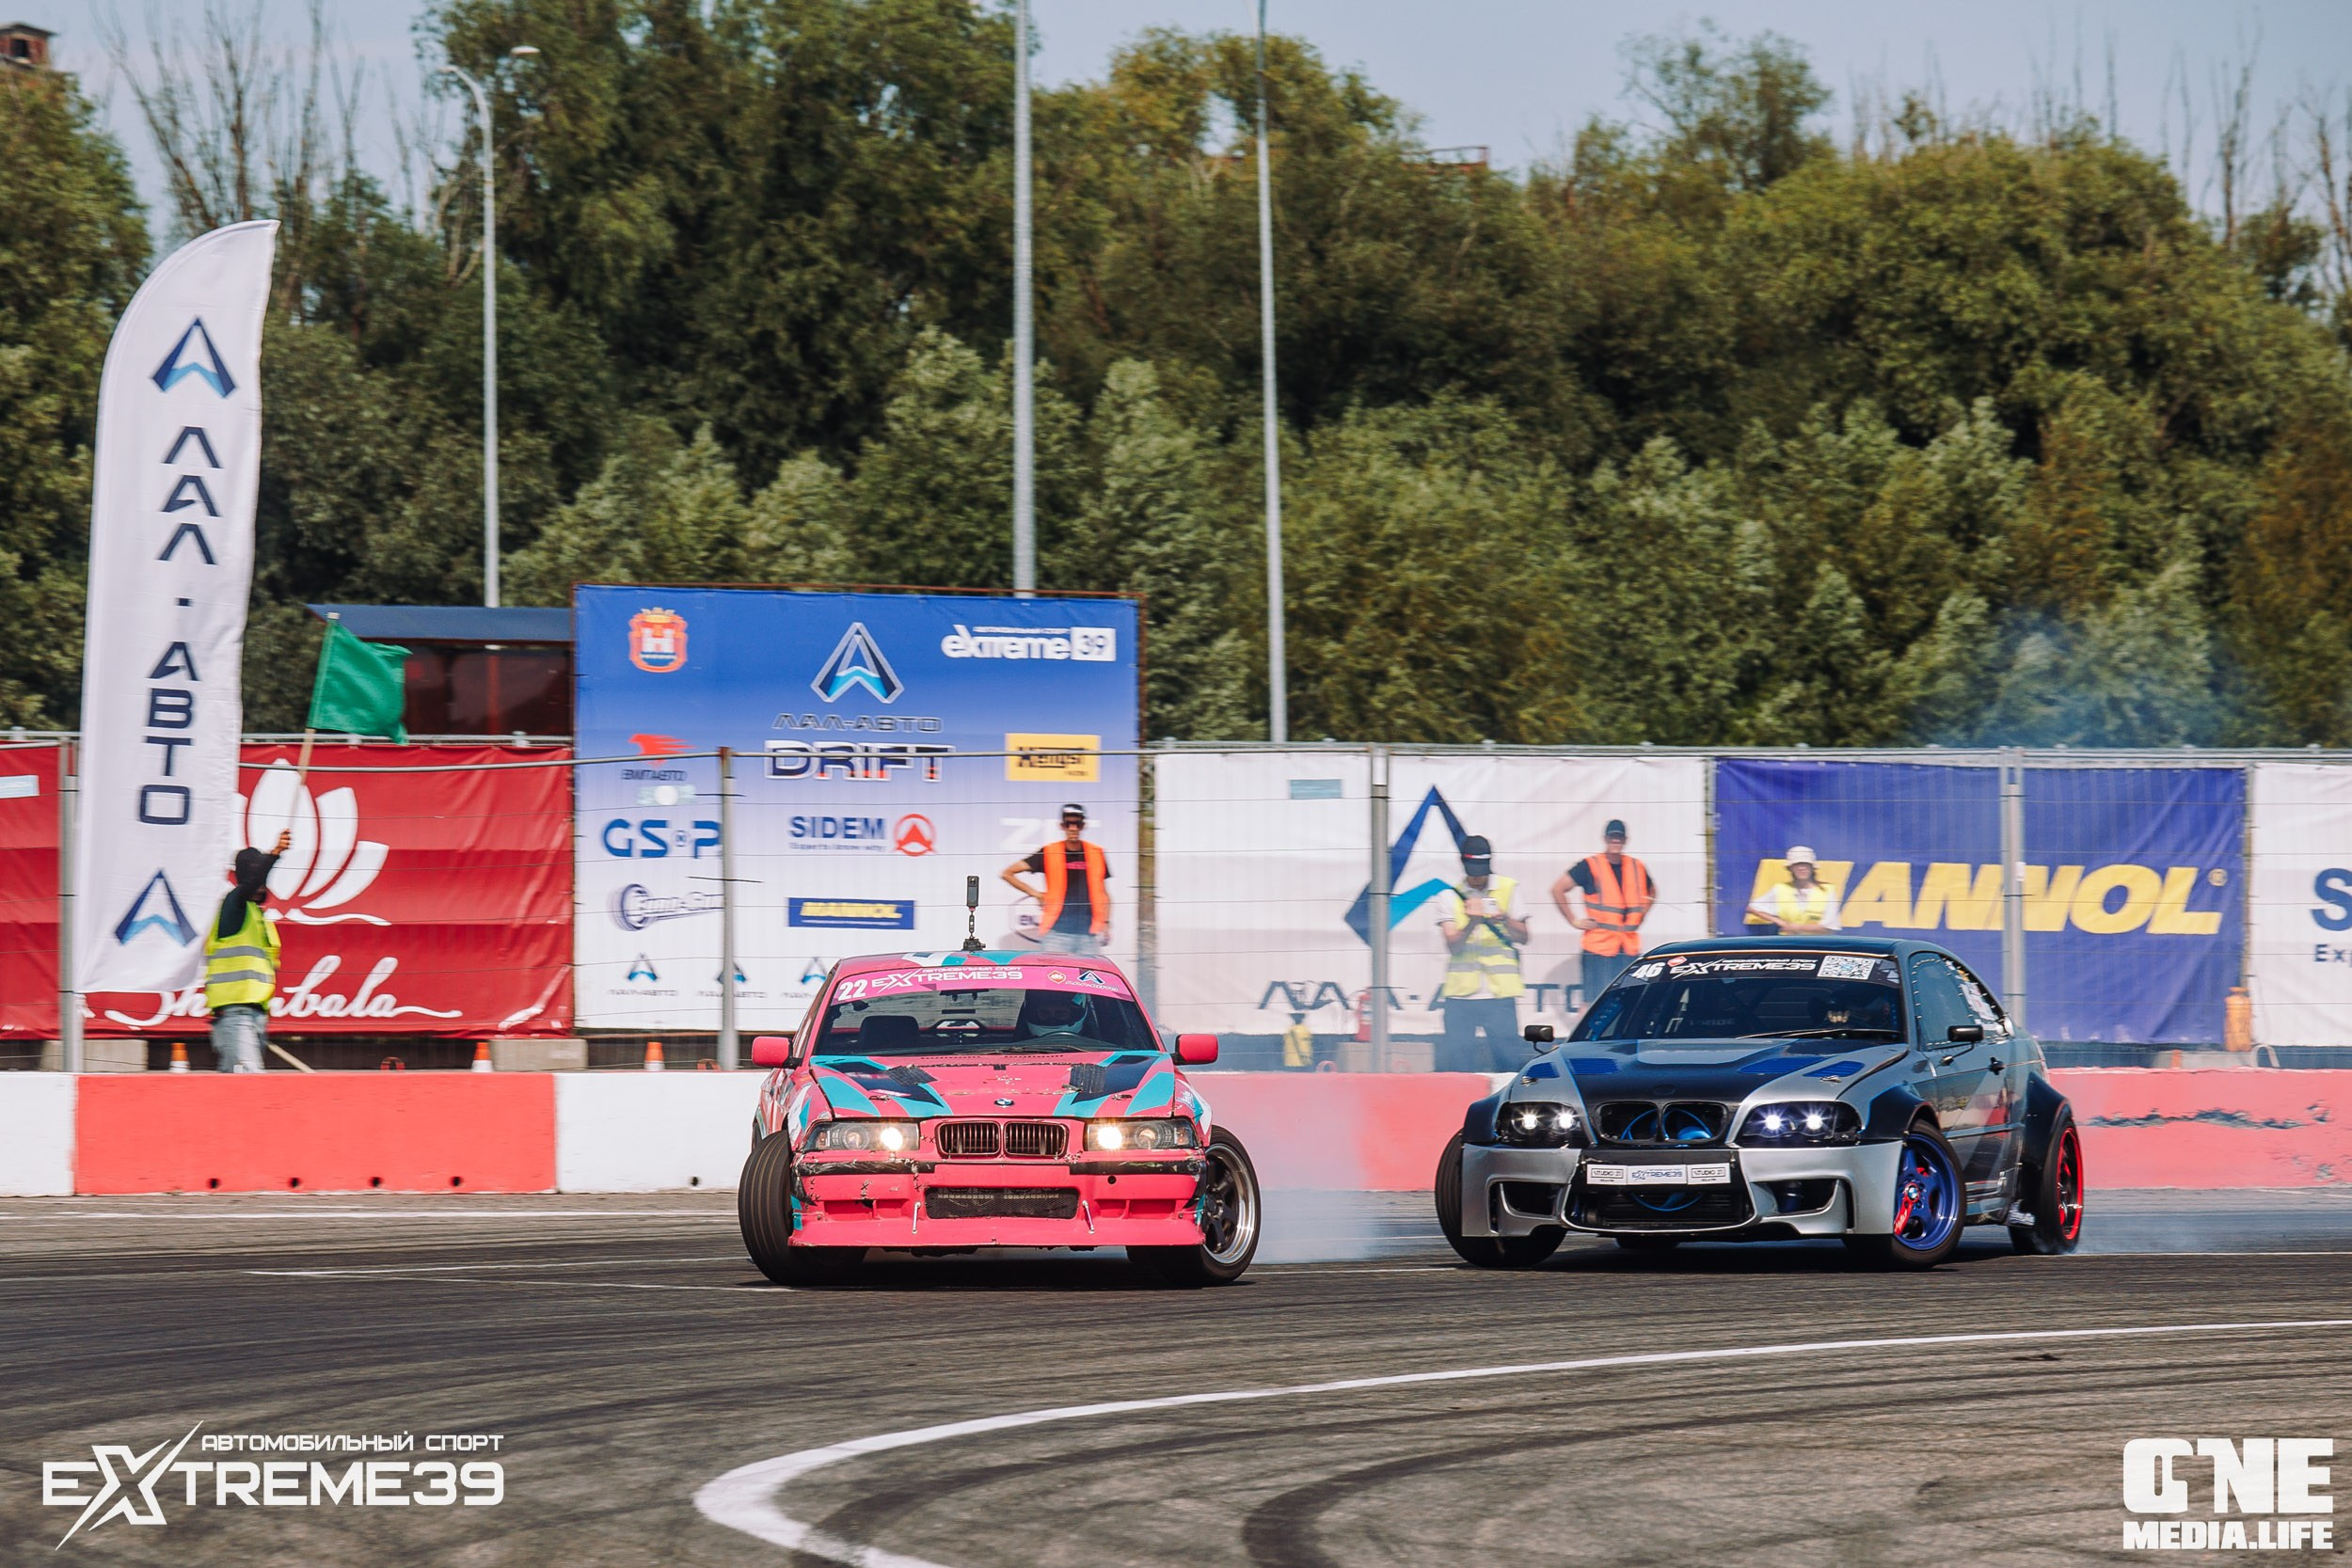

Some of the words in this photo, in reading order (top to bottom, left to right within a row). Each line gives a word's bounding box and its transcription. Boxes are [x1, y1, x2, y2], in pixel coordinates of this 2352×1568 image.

[764, 740, 956, 783] DRIFT
[789, 816, 886, 839] SIDEM
[1632, 962, 1664, 978] 46
[837, 979, 867, 1001] 22
